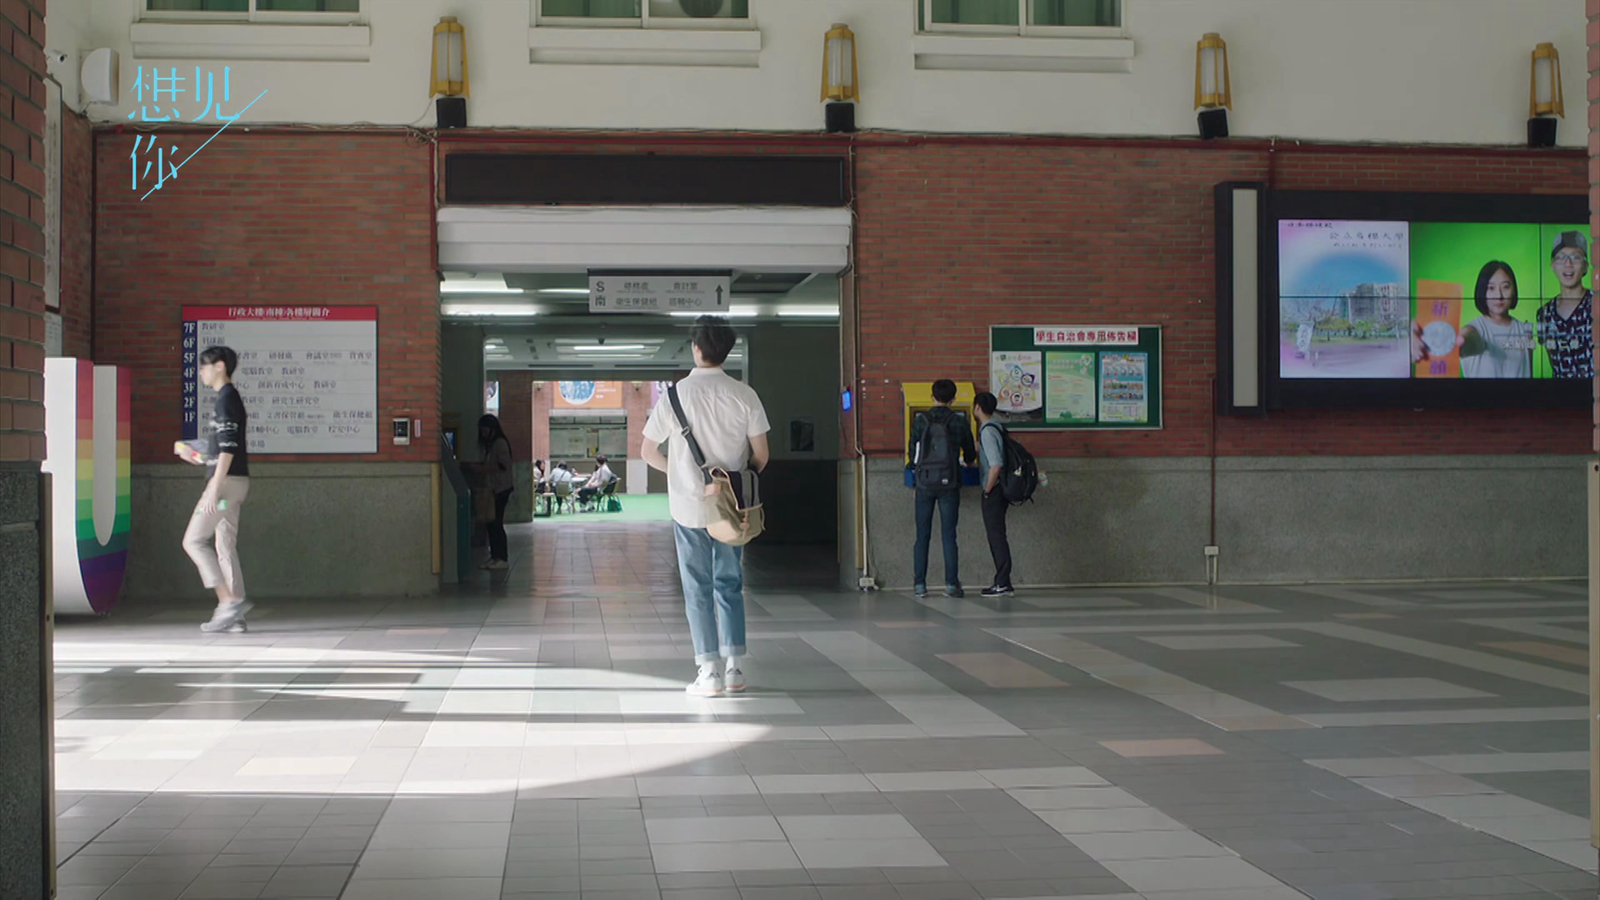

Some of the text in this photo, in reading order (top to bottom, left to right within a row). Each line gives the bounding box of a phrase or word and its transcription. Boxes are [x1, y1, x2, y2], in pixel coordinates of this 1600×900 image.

[596, 281, 605, 293] S
[595, 295, 606, 307] 南
[183, 322, 196, 333] 7F
[183, 337, 196, 348] 6F
[183, 352, 196, 363] 5F
[183, 367, 196, 378] 4F
[183, 382, 196, 393] 3F
[183, 397, 196, 408] 2F
[184, 412, 196, 422] 1F
